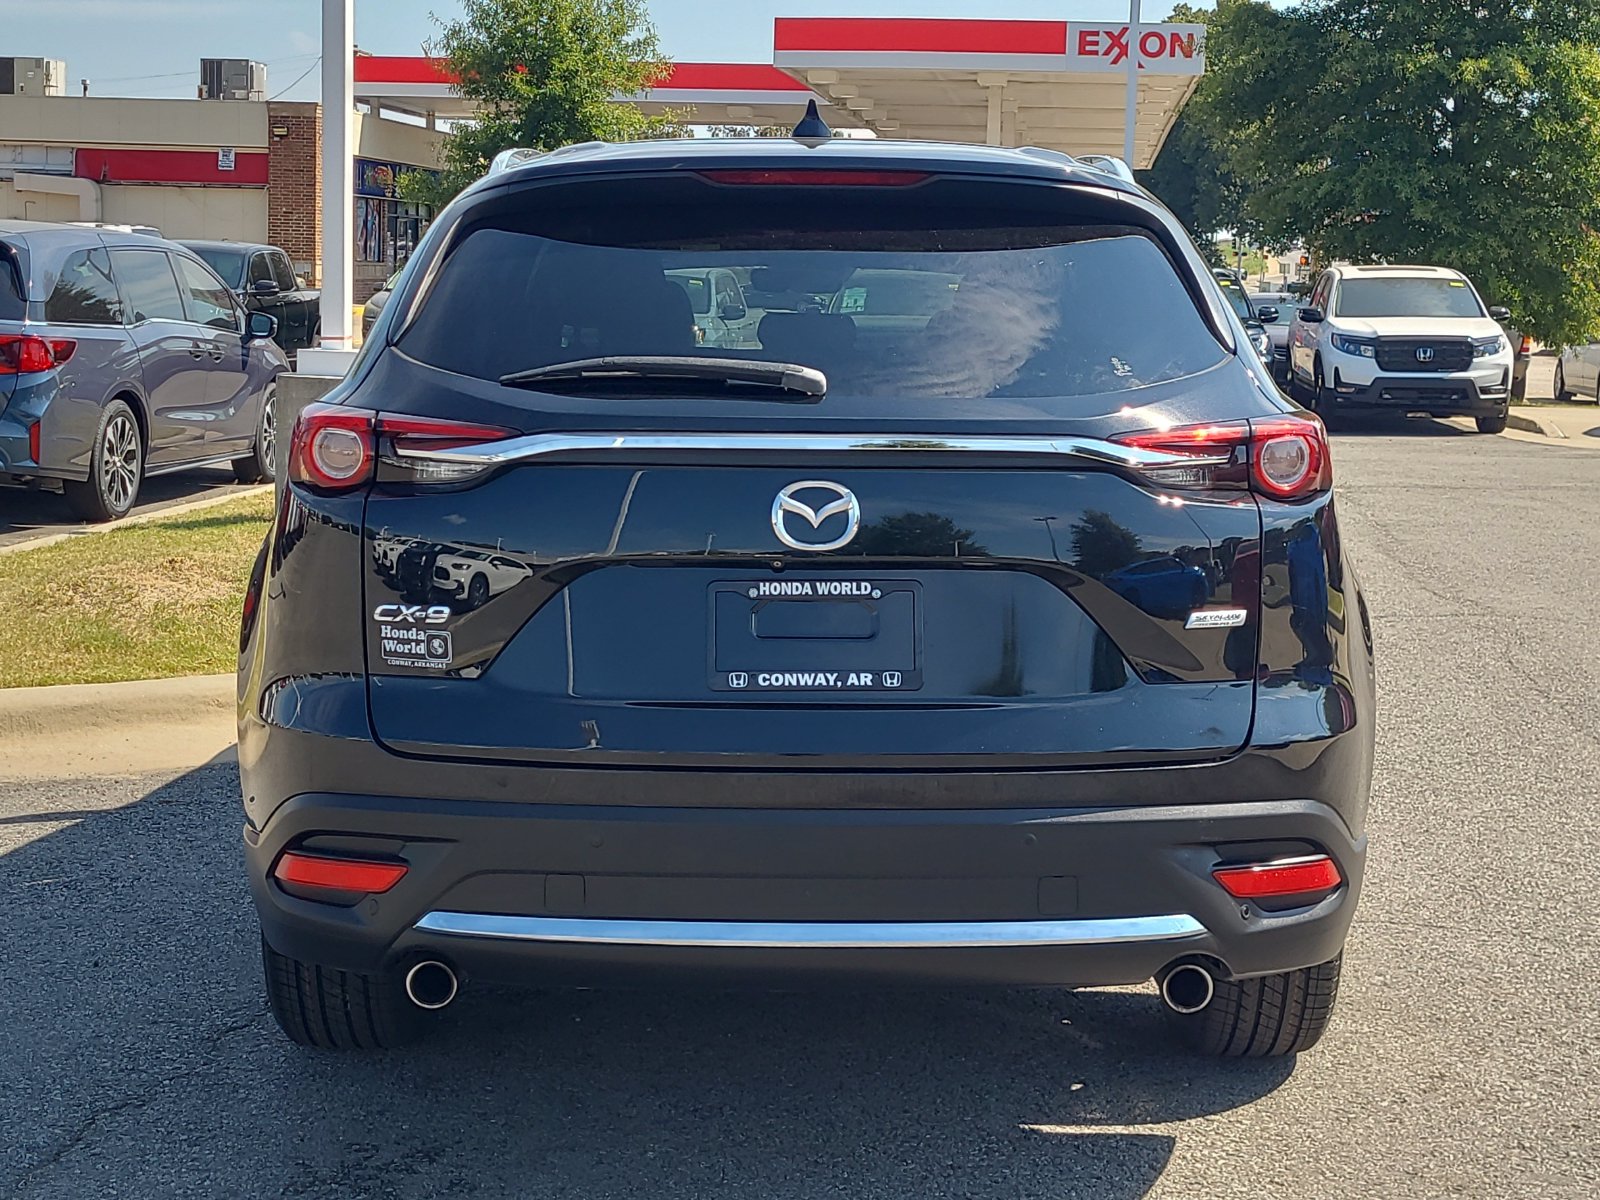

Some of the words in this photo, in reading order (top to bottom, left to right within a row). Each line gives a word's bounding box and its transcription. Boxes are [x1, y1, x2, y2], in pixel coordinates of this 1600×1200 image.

[760, 582, 813, 595] HONDA
[816, 582, 871, 595] WORLD
[374, 605, 450, 623] CX-9
[381, 625, 425, 640] Honda
[384, 640, 425, 654] World
[758, 673, 843, 688] CONWAY,
[846, 673, 873, 686] AR
